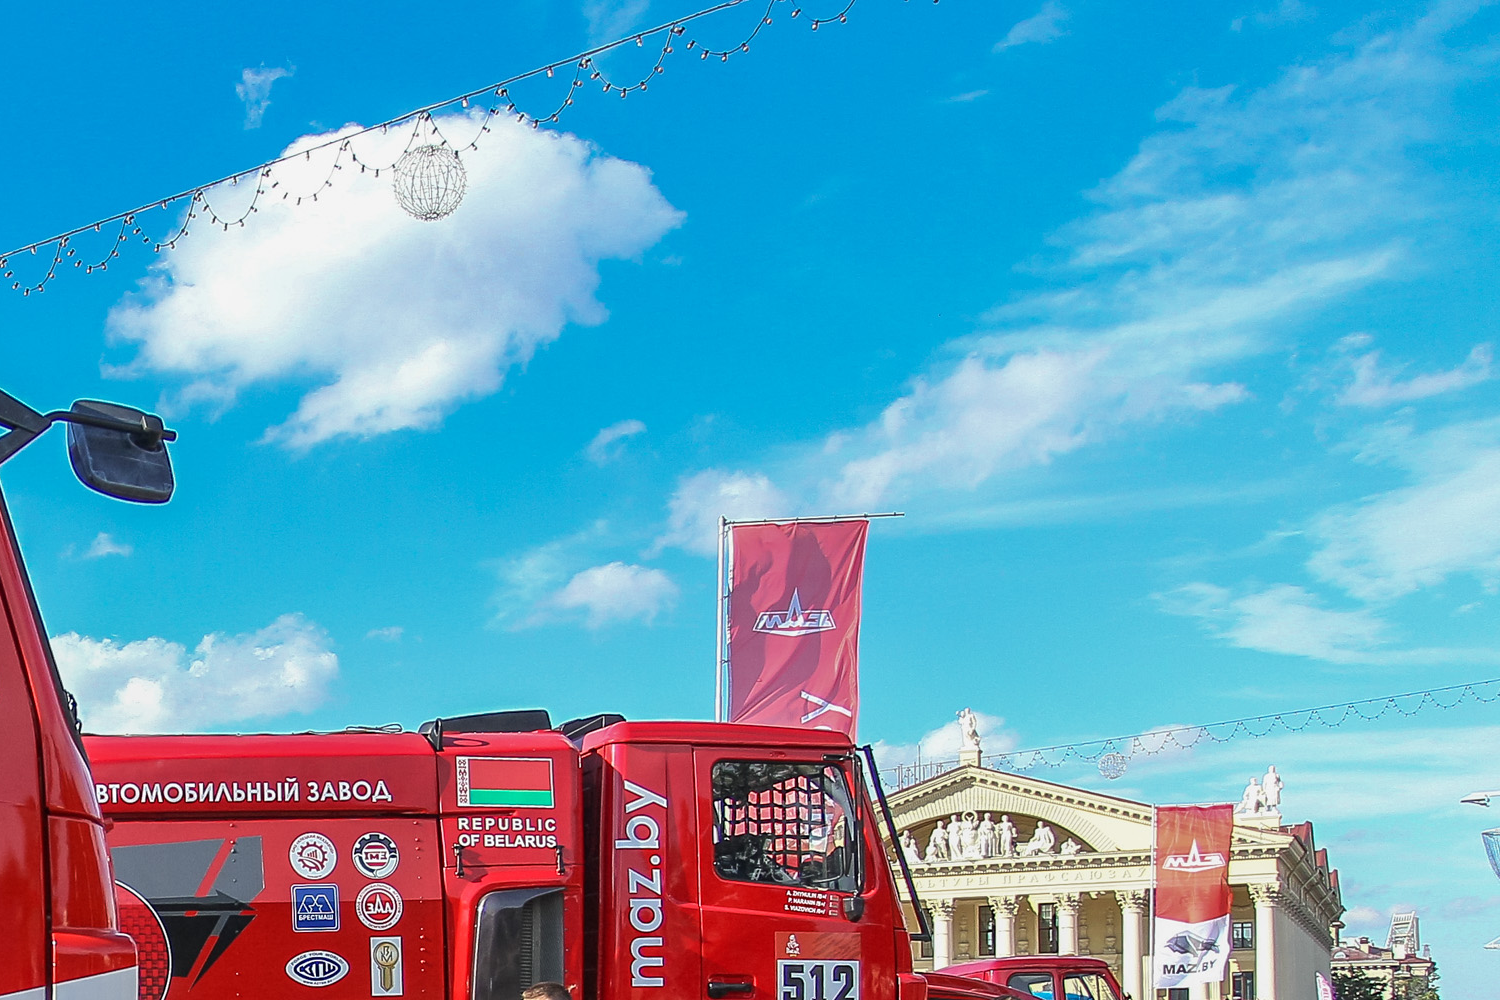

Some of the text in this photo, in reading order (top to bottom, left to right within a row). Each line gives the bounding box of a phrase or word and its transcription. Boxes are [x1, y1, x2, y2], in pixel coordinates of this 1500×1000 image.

[96, 777, 392, 804] ВТОМОБИЛЬНЫЙ ЗАВОД
[457, 817, 557, 832] REPUBLIC
[458, 834, 557, 848] OF BELARUS
[615, 780, 668, 987] maz.by
[915, 876, 990, 890] ЛЬТУРЫ
[1162, 959, 1217, 975] MAZ.BY
